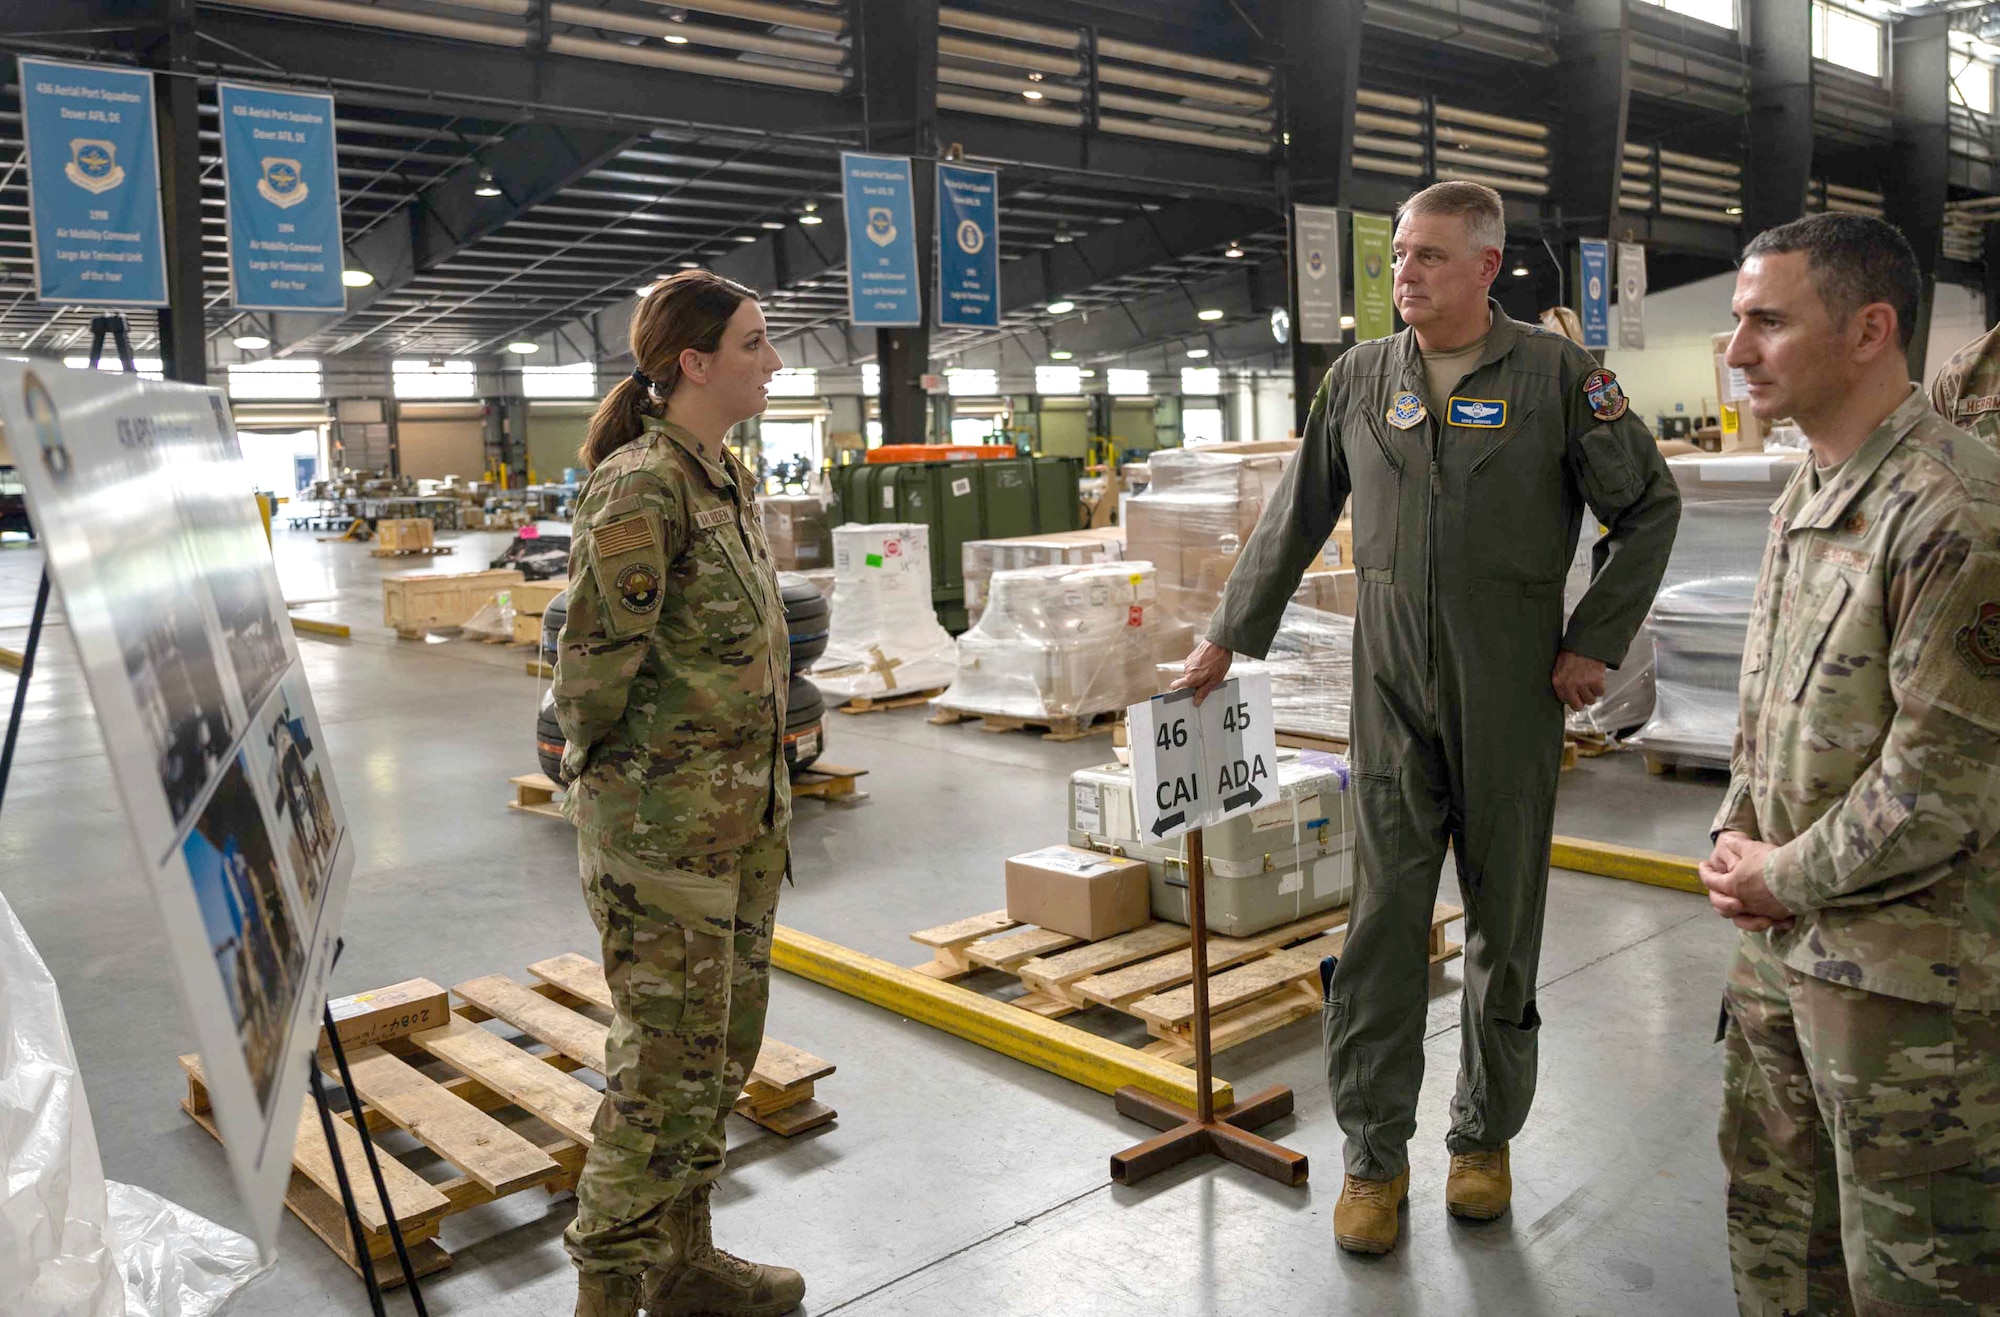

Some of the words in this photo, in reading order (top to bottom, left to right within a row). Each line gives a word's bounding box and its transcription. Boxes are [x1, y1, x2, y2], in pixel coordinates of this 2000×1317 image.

[61, 107, 86, 120] Dover
[253, 128, 278, 140] Dover
[1223, 702, 1251, 733] 45
[1156, 718, 1188, 751] 46
[1218, 754, 1268, 794] ADA
[1156, 773, 1198, 811] CAI
